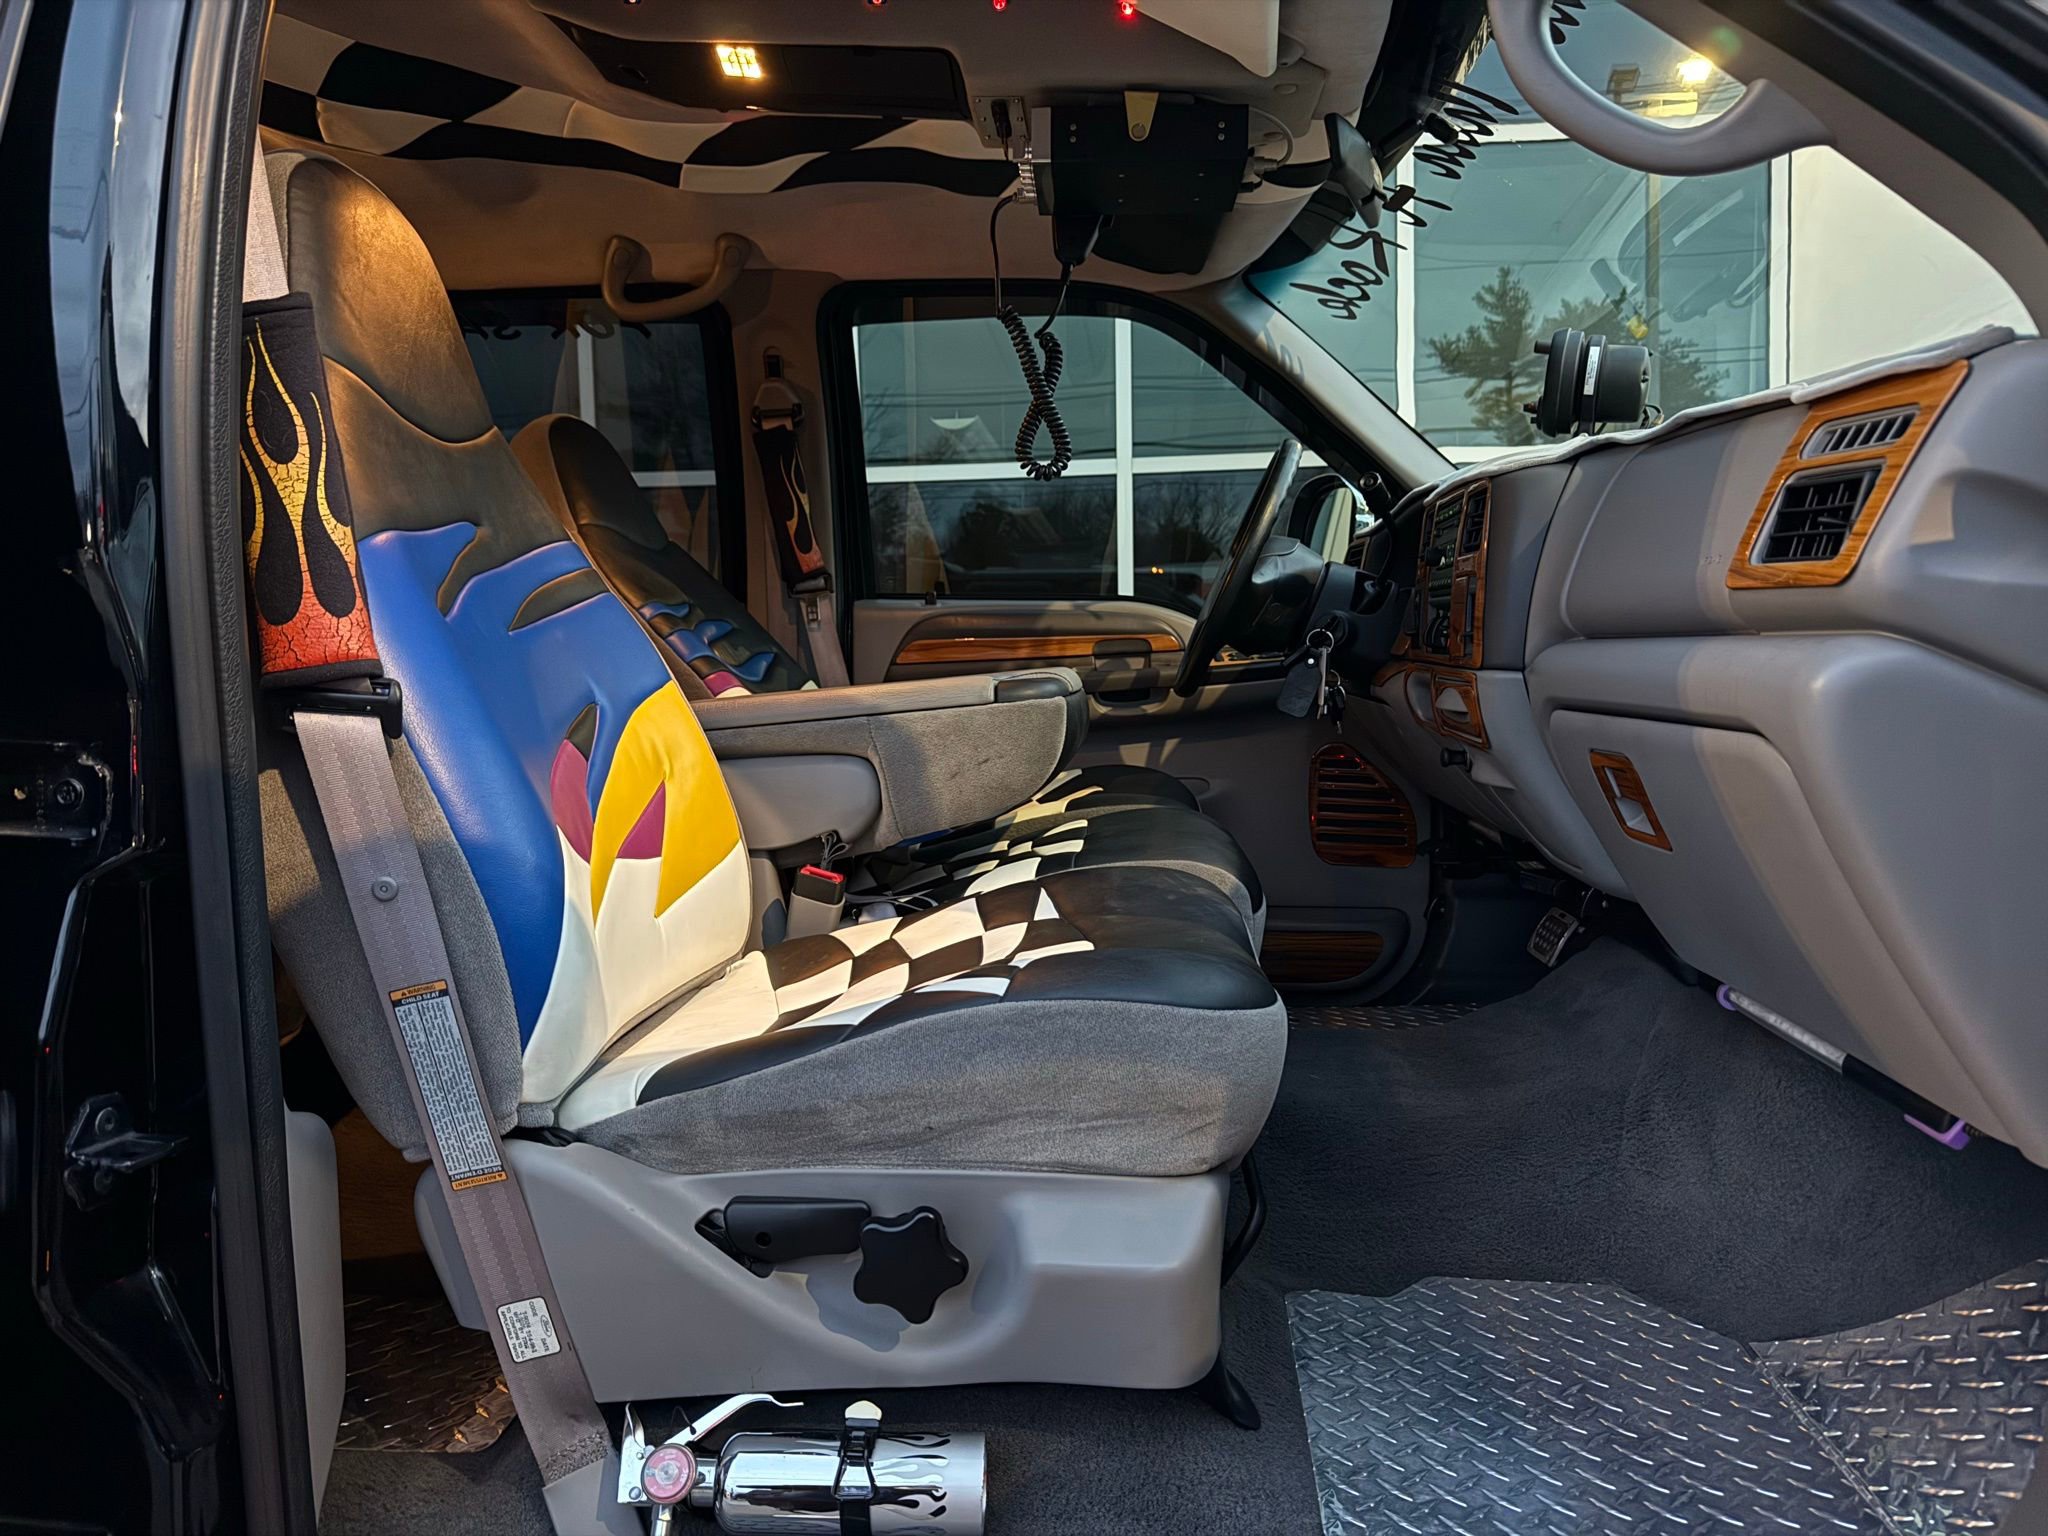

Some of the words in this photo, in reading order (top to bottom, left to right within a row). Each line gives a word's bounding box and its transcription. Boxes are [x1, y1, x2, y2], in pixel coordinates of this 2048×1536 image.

[406, 984, 436, 994] WARNING
[401, 995, 422, 1005] CHILD
[422, 991, 440, 1001] SEAT
[529, 1301, 538, 1316] CODE
[541, 1338, 550, 1352] DATE
